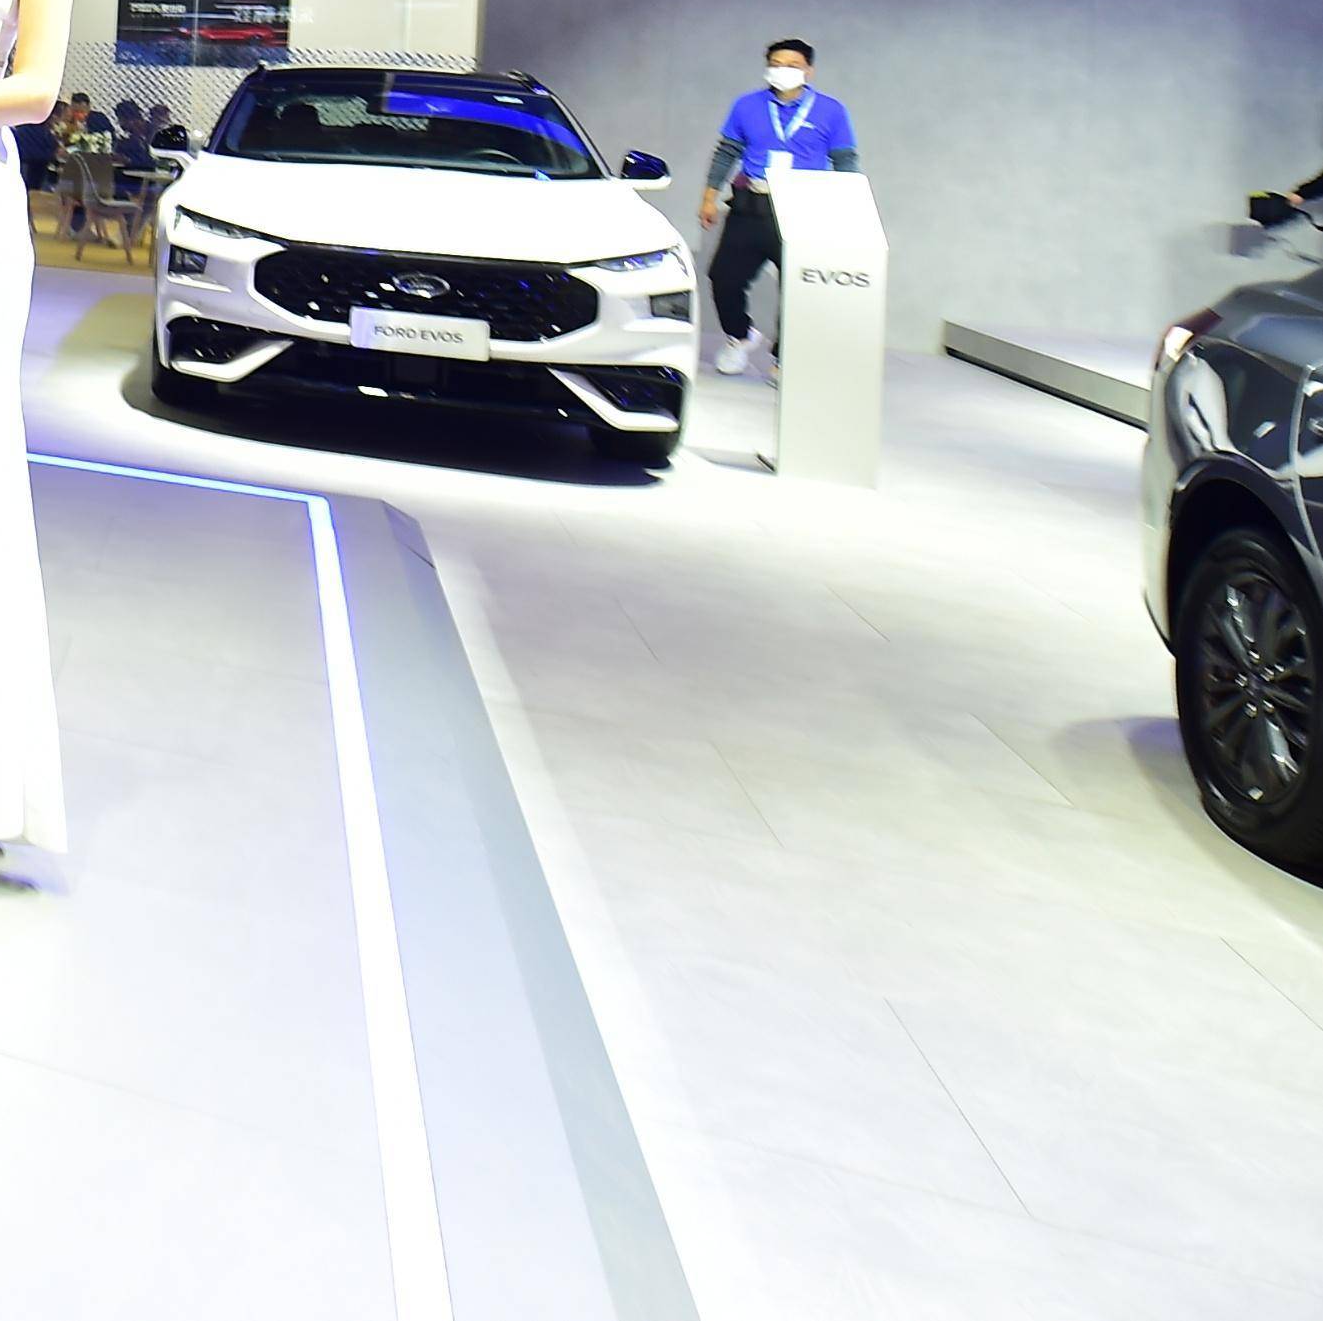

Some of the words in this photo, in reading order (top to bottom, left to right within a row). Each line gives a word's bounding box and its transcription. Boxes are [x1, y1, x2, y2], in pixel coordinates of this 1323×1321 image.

[803, 269, 870, 288] EVOS
[373, 325, 418, 340] FORD
[420, 329, 464, 344] EVOS
